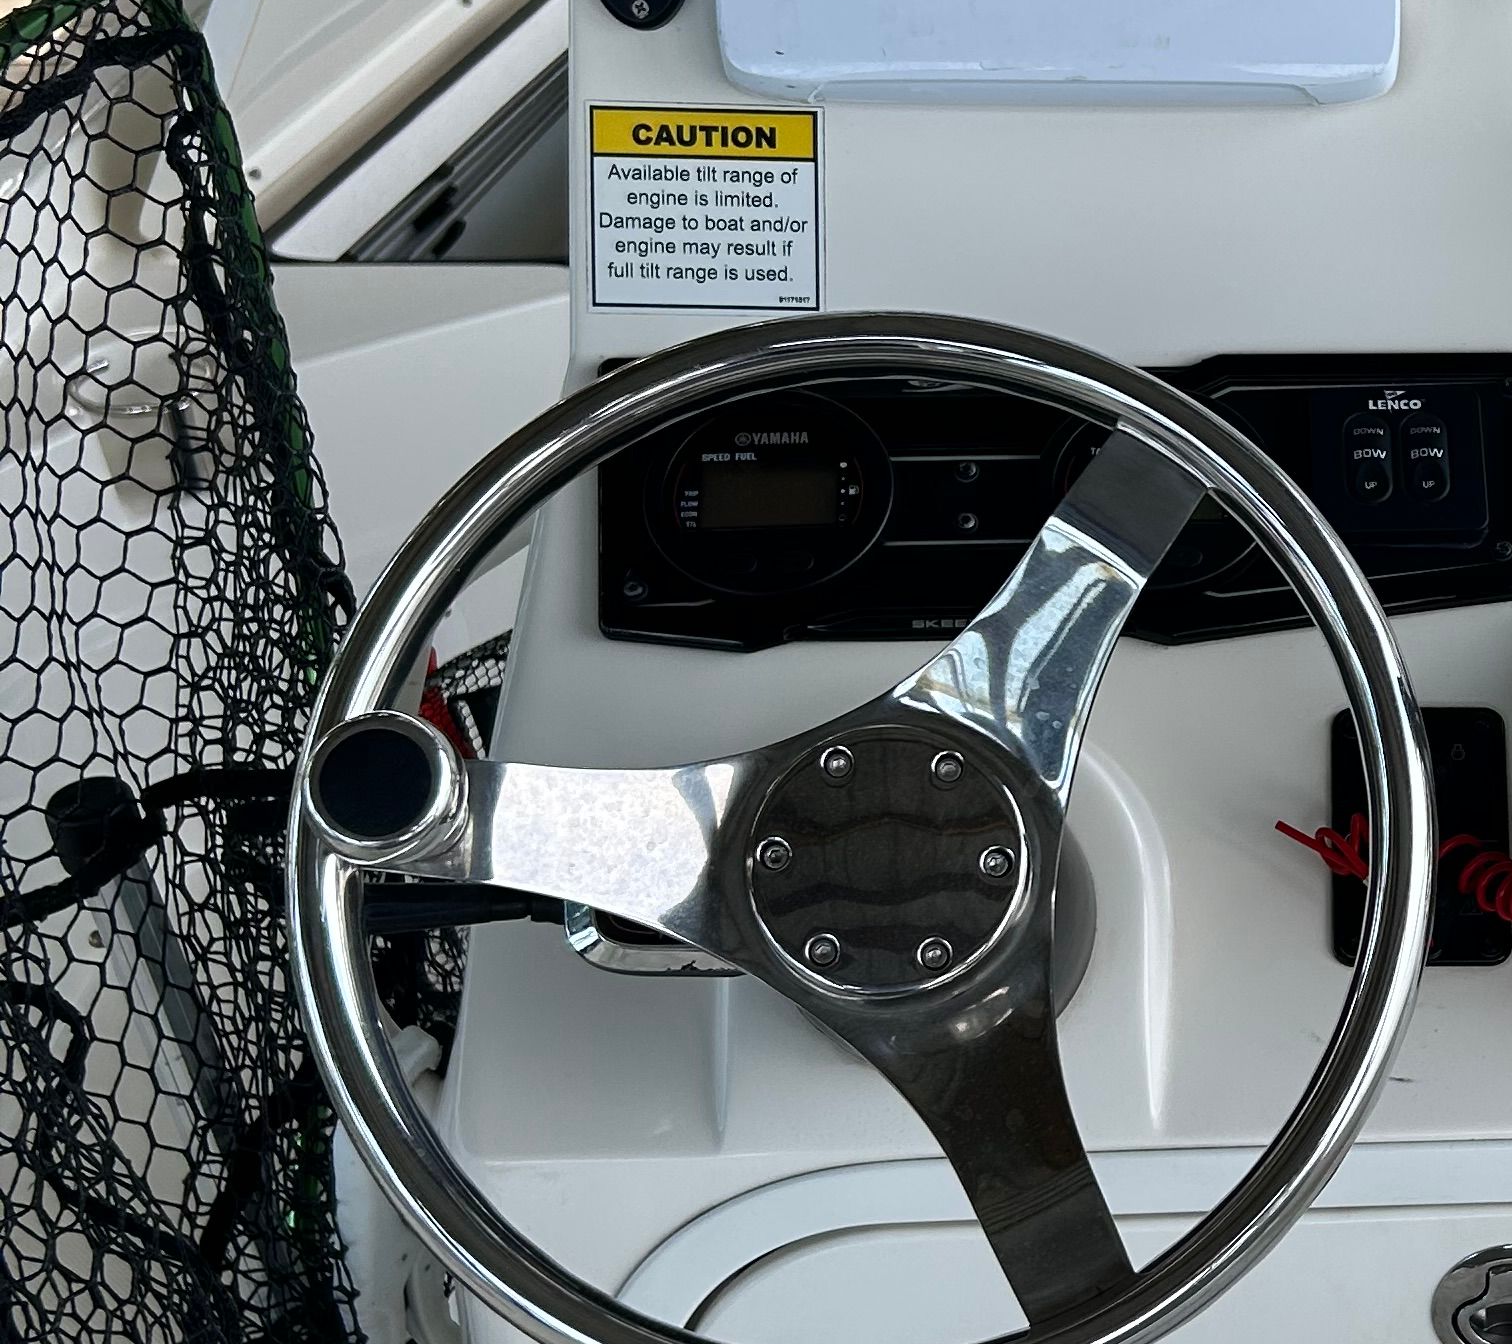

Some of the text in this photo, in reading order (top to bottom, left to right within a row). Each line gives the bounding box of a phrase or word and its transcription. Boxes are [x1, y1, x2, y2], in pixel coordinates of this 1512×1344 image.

[631, 123, 777, 149] CAUTION
[608, 164, 798, 187] Available tilt range of
[627, 190, 778, 209] engine is limited.
[599, 212, 809, 233] Damage to boat and/or
[615, 238, 793, 259] engine may result if
[608, 262, 793, 284] full tilt range is used.
[1368, 399, 1422, 410] LENCO
[1353, 427, 1384, 436] DOWN
[1409, 426, 1441, 435] DOWN
[751, 431, 809, 445] YAMAHA
[702, 452, 758, 462] SPEED FUEL
[1353, 448, 1387, 460] BOW
[1410, 447, 1444, 460] BOW
[1364, 480, 1378, 490] UP
[1422, 480, 1436, 489] UP
